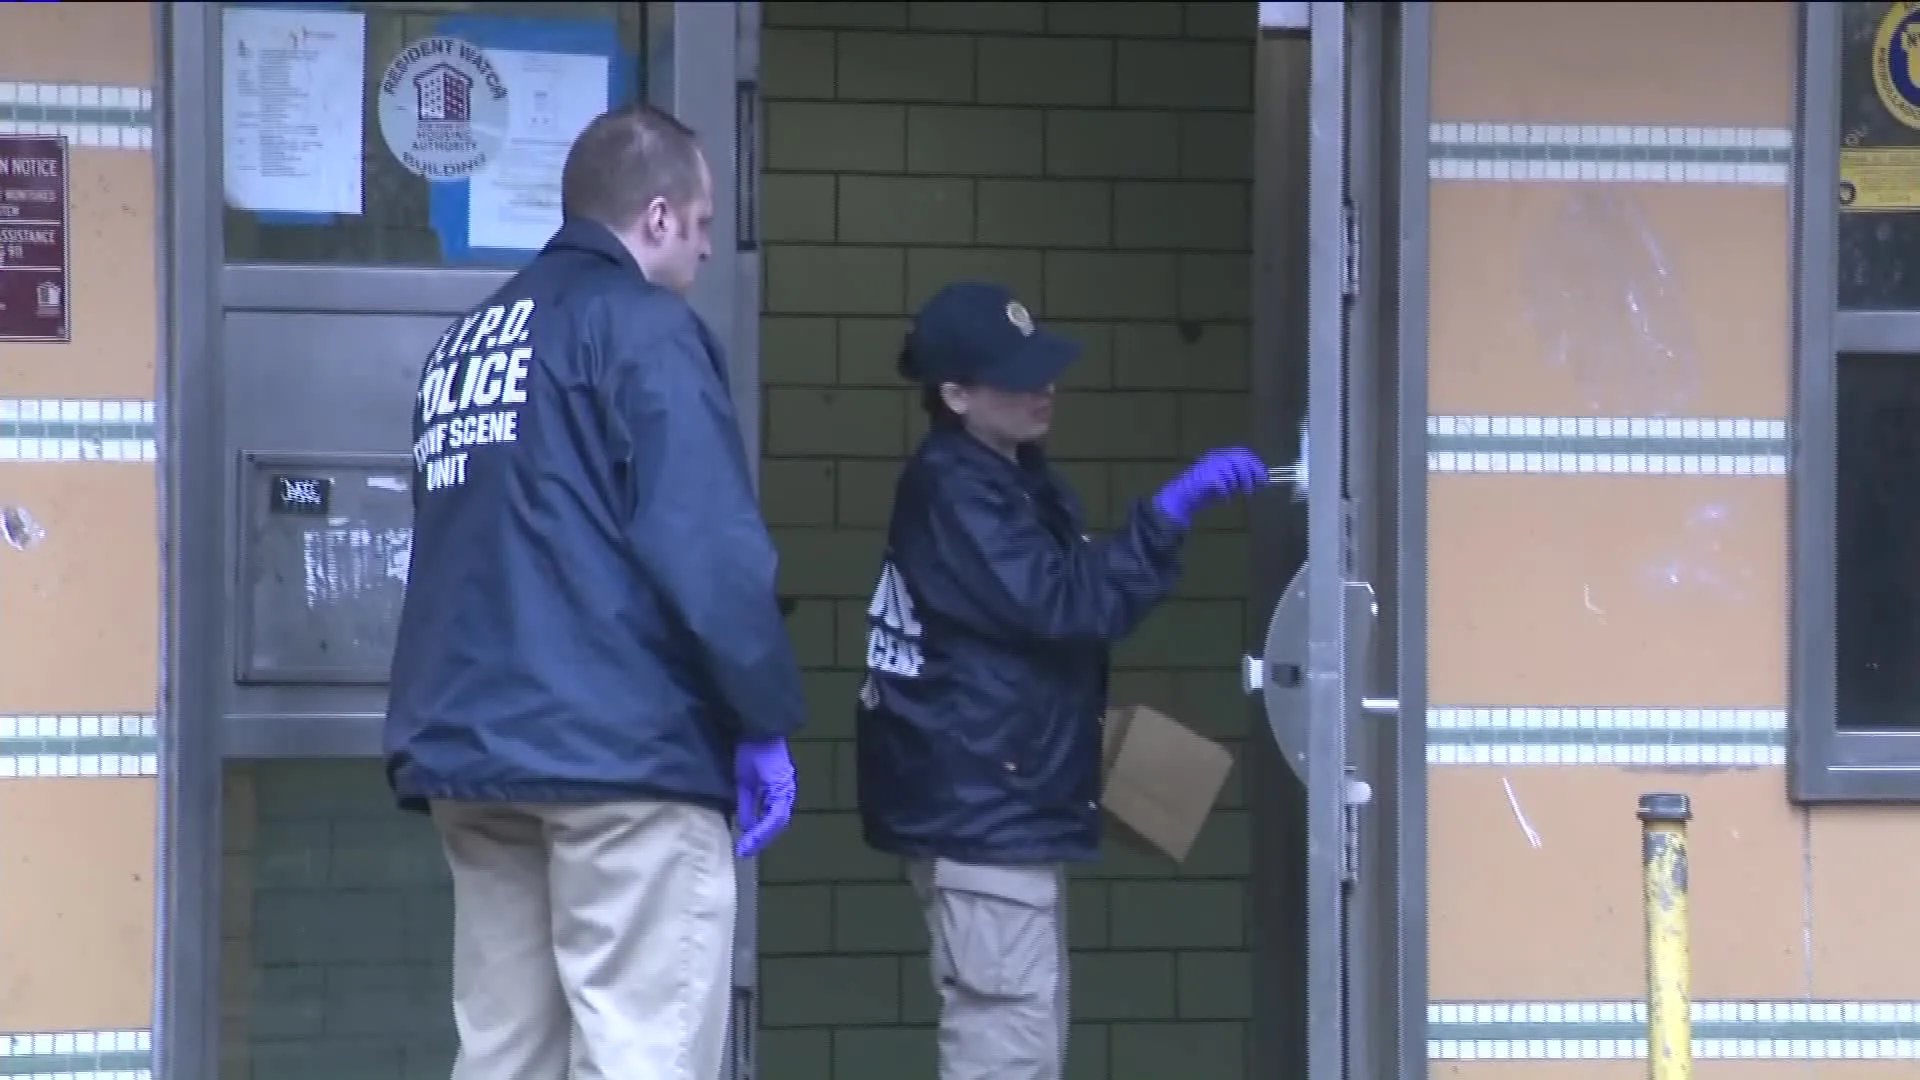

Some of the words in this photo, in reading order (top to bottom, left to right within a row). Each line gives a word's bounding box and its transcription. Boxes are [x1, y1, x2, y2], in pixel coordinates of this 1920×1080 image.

[384, 39, 454, 96] RESIDENT
[459, 43, 508, 98] WATCH
[411, 140, 478, 152] AUTHORITY
[12, 158, 58, 177] NOTICE
[402, 151, 486, 176] BUILDING
[418, 347, 533, 423] OLICE
[448, 411, 518, 448] SCENE
